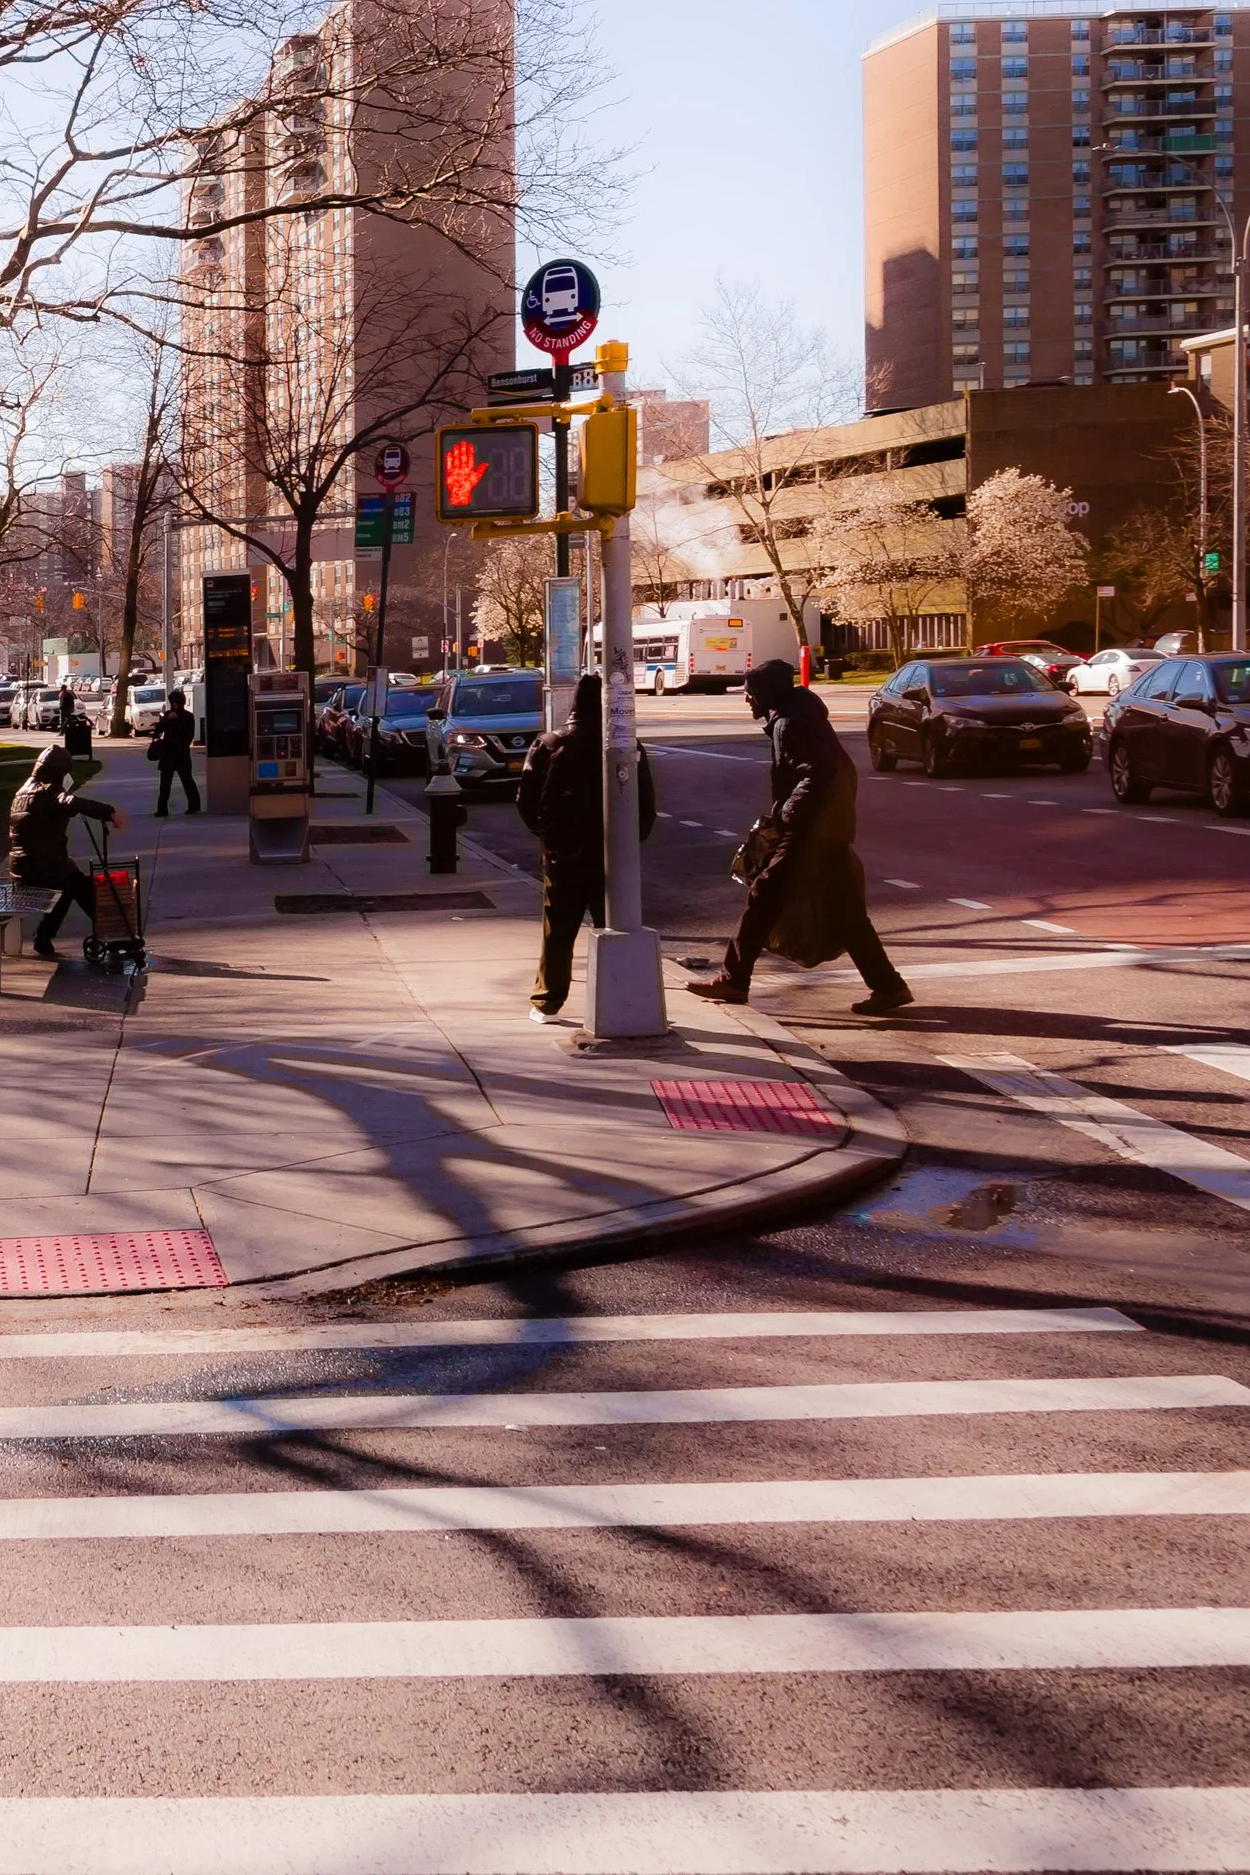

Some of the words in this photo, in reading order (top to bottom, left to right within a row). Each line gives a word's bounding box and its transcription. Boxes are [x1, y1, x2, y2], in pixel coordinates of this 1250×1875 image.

[529, 327, 543, 343] NO
[543, 320, 592, 349] STANDING
[491, 374, 537, 387] Bensonhurst
[572, 369, 599, 389] B8
[395, 493, 411, 502] B82
[394, 507, 410, 516] B83
[393, 519, 410, 529] BM2
[392, 532, 409, 542] BM5
